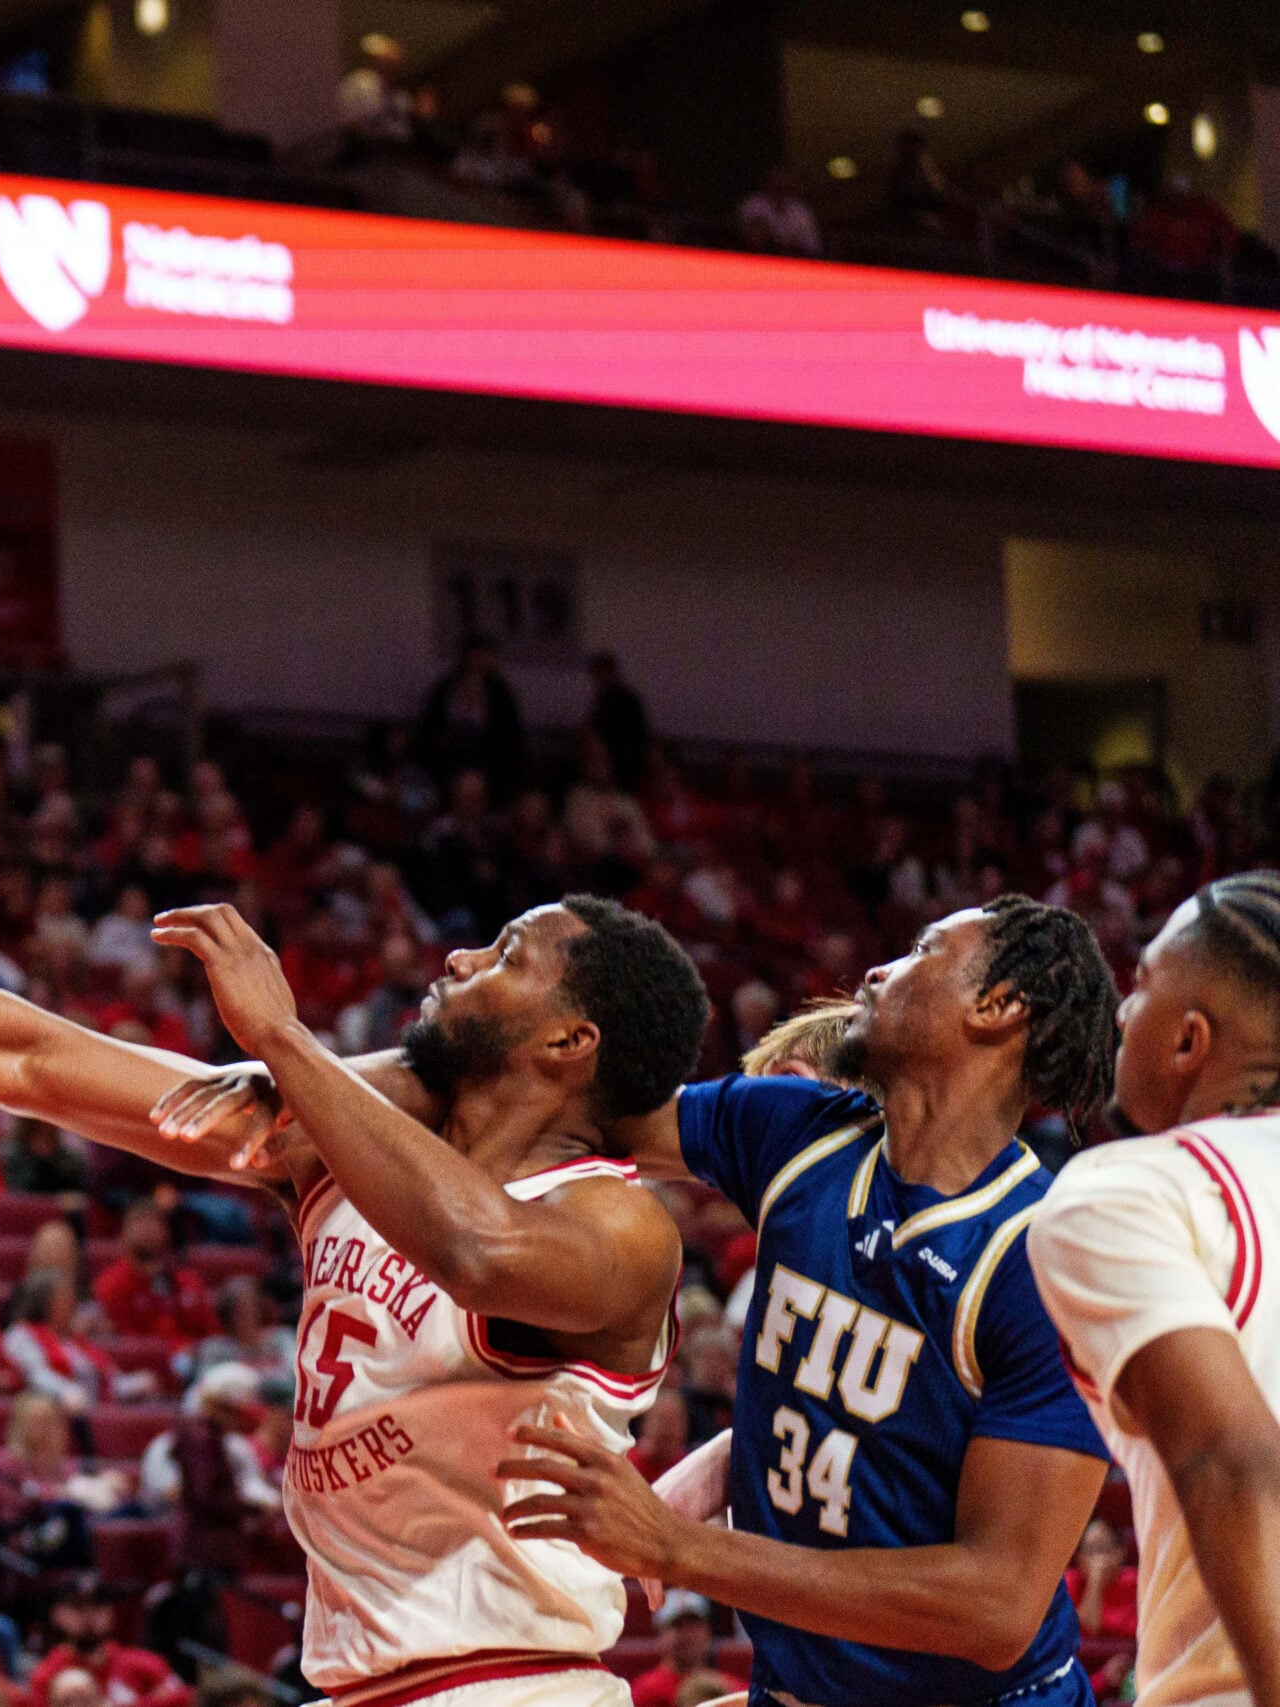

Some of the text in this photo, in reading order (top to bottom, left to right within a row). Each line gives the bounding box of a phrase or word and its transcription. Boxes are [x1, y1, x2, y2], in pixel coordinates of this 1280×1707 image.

[123, 221, 293, 283] Nebraska
[294, 1302, 377, 1429] 15
[756, 1262, 925, 1424] FIU
[767, 1405, 859, 1537] 34
